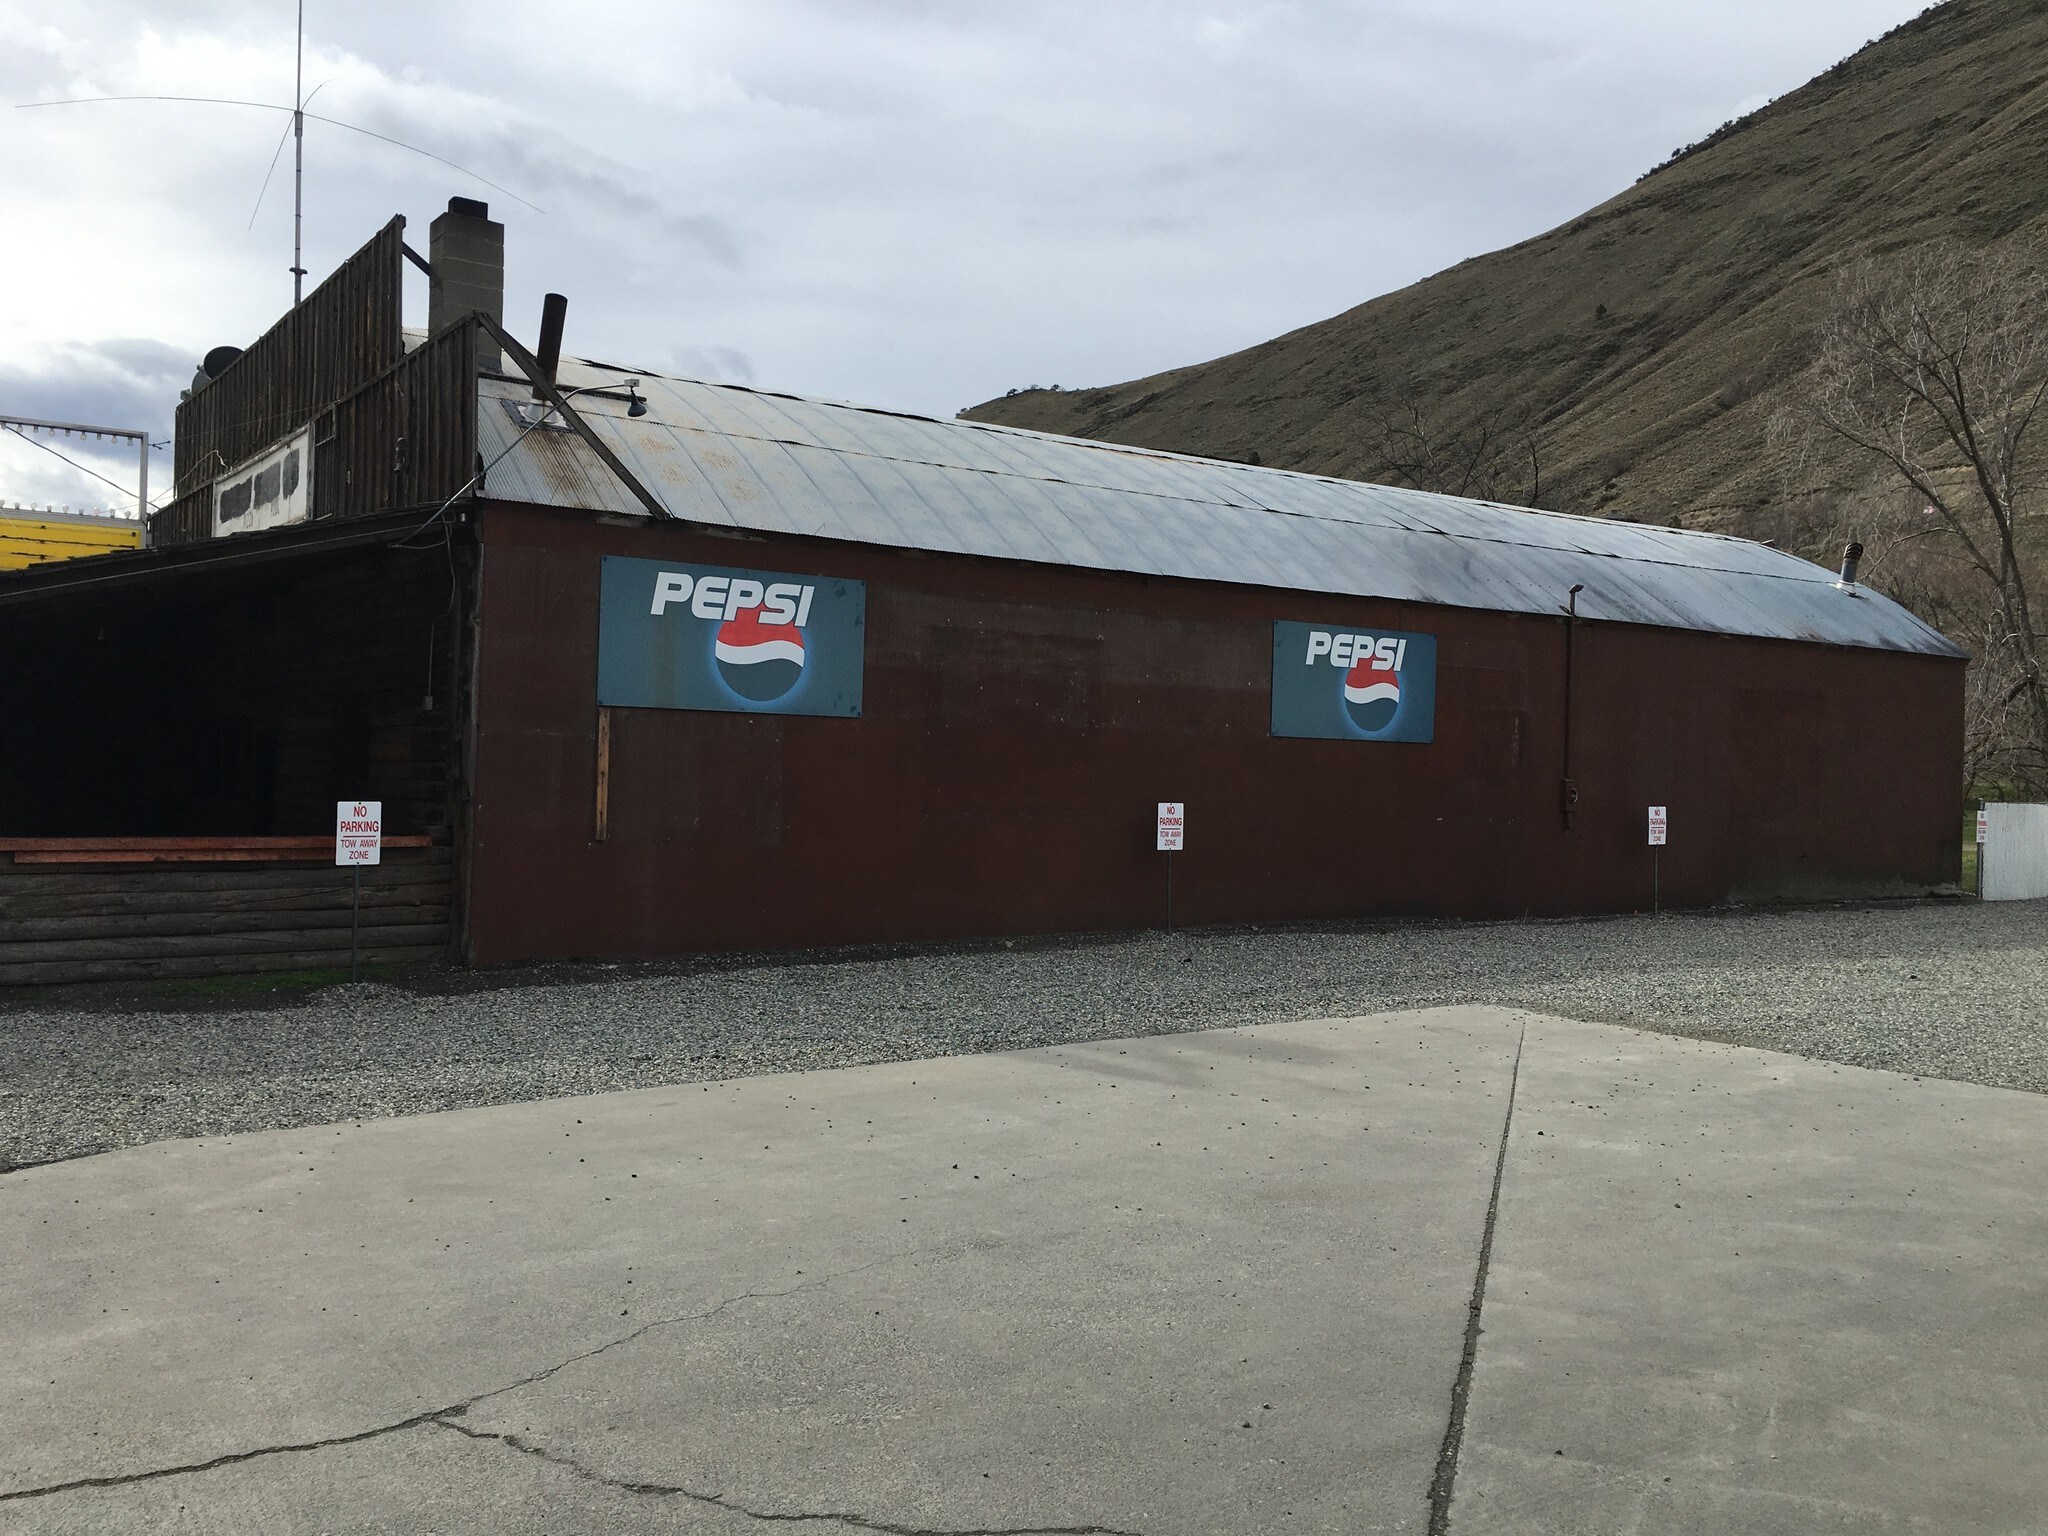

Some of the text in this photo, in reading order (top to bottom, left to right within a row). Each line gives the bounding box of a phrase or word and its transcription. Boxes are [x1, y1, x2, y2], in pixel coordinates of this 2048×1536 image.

[650, 571, 816, 628] PEPSI
[1305, 631, 1407, 672] PEPSI
[353, 805, 368, 818] NO
[1166, 805, 1176, 815] NO
[340, 820, 379, 833] PARKING
[1159, 817, 1183, 826] PARKING
[340, 839, 379, 848] TOW AWAY
[348, 850, 369, 860] ZONE
